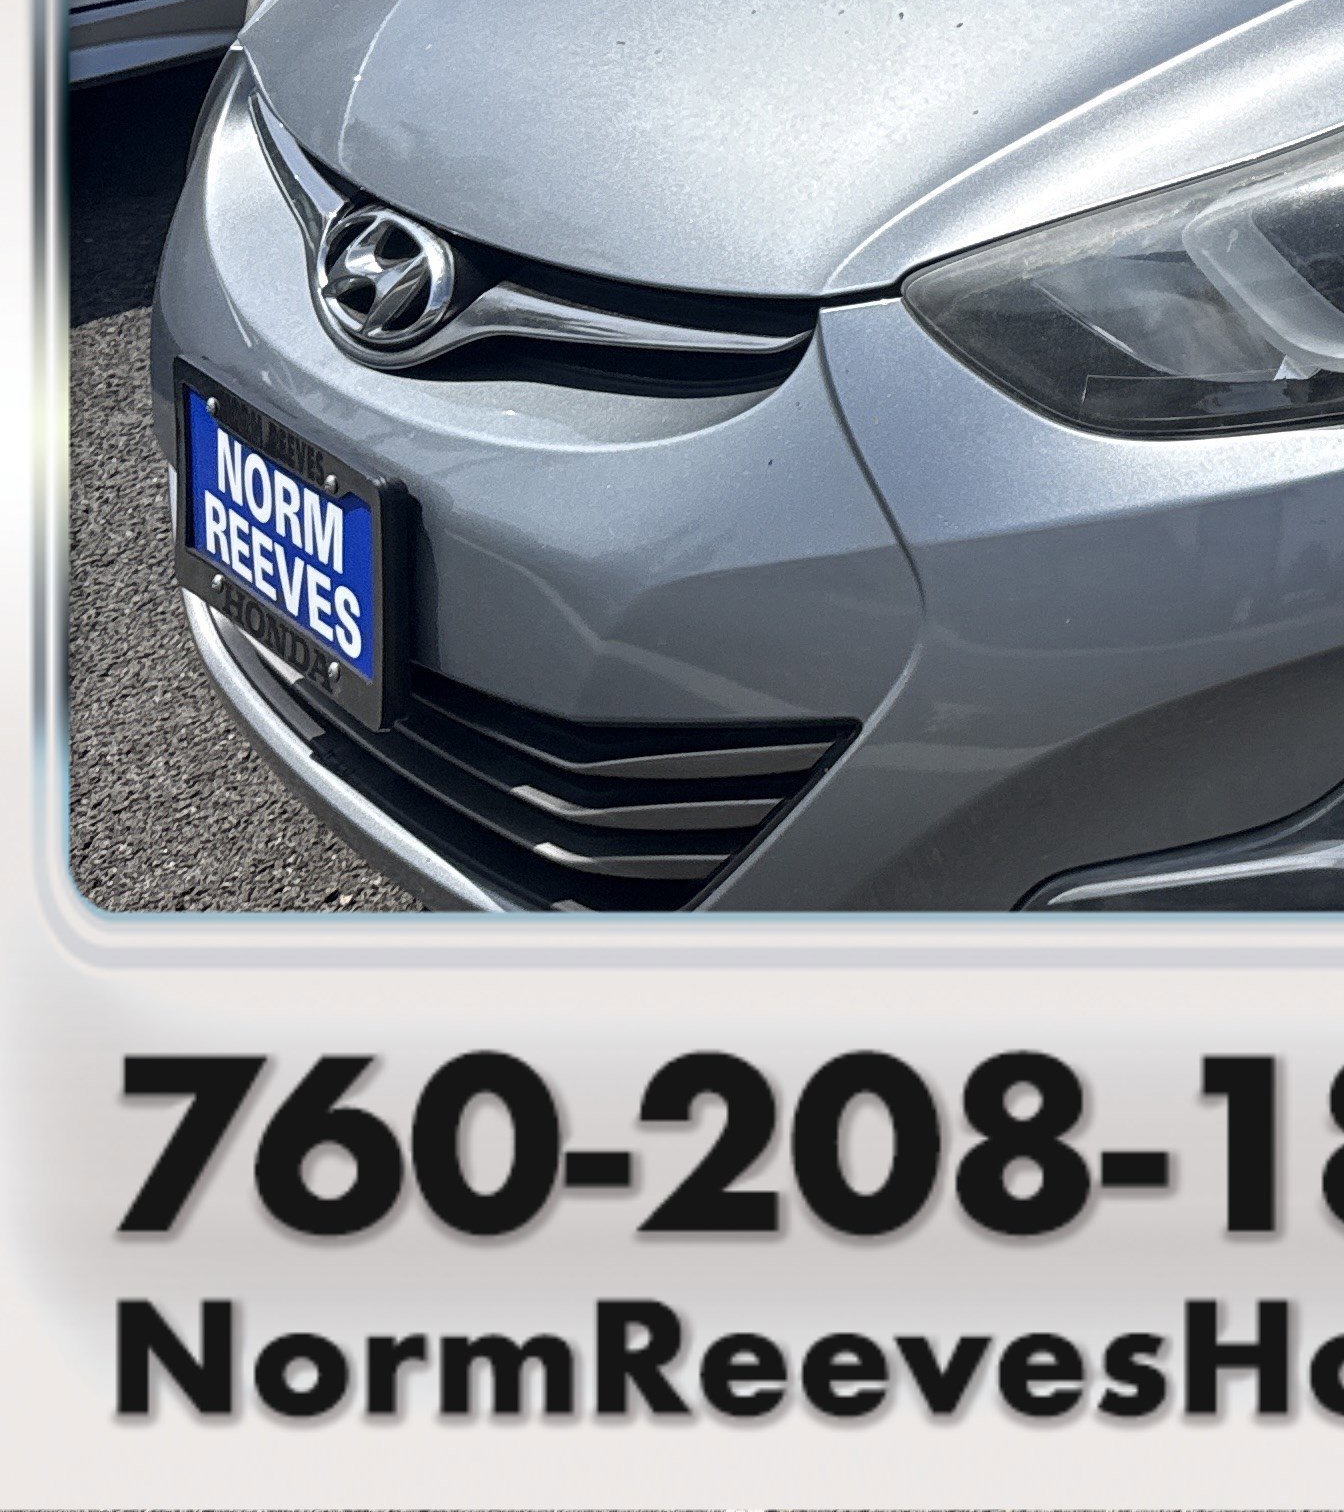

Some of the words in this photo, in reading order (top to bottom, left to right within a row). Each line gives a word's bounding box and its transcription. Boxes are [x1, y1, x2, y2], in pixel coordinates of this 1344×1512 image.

[204, 490, 362, 659] REEVES
[217, 427, 344, 575] NORM
[225, 580, 333, 694] HONDA
